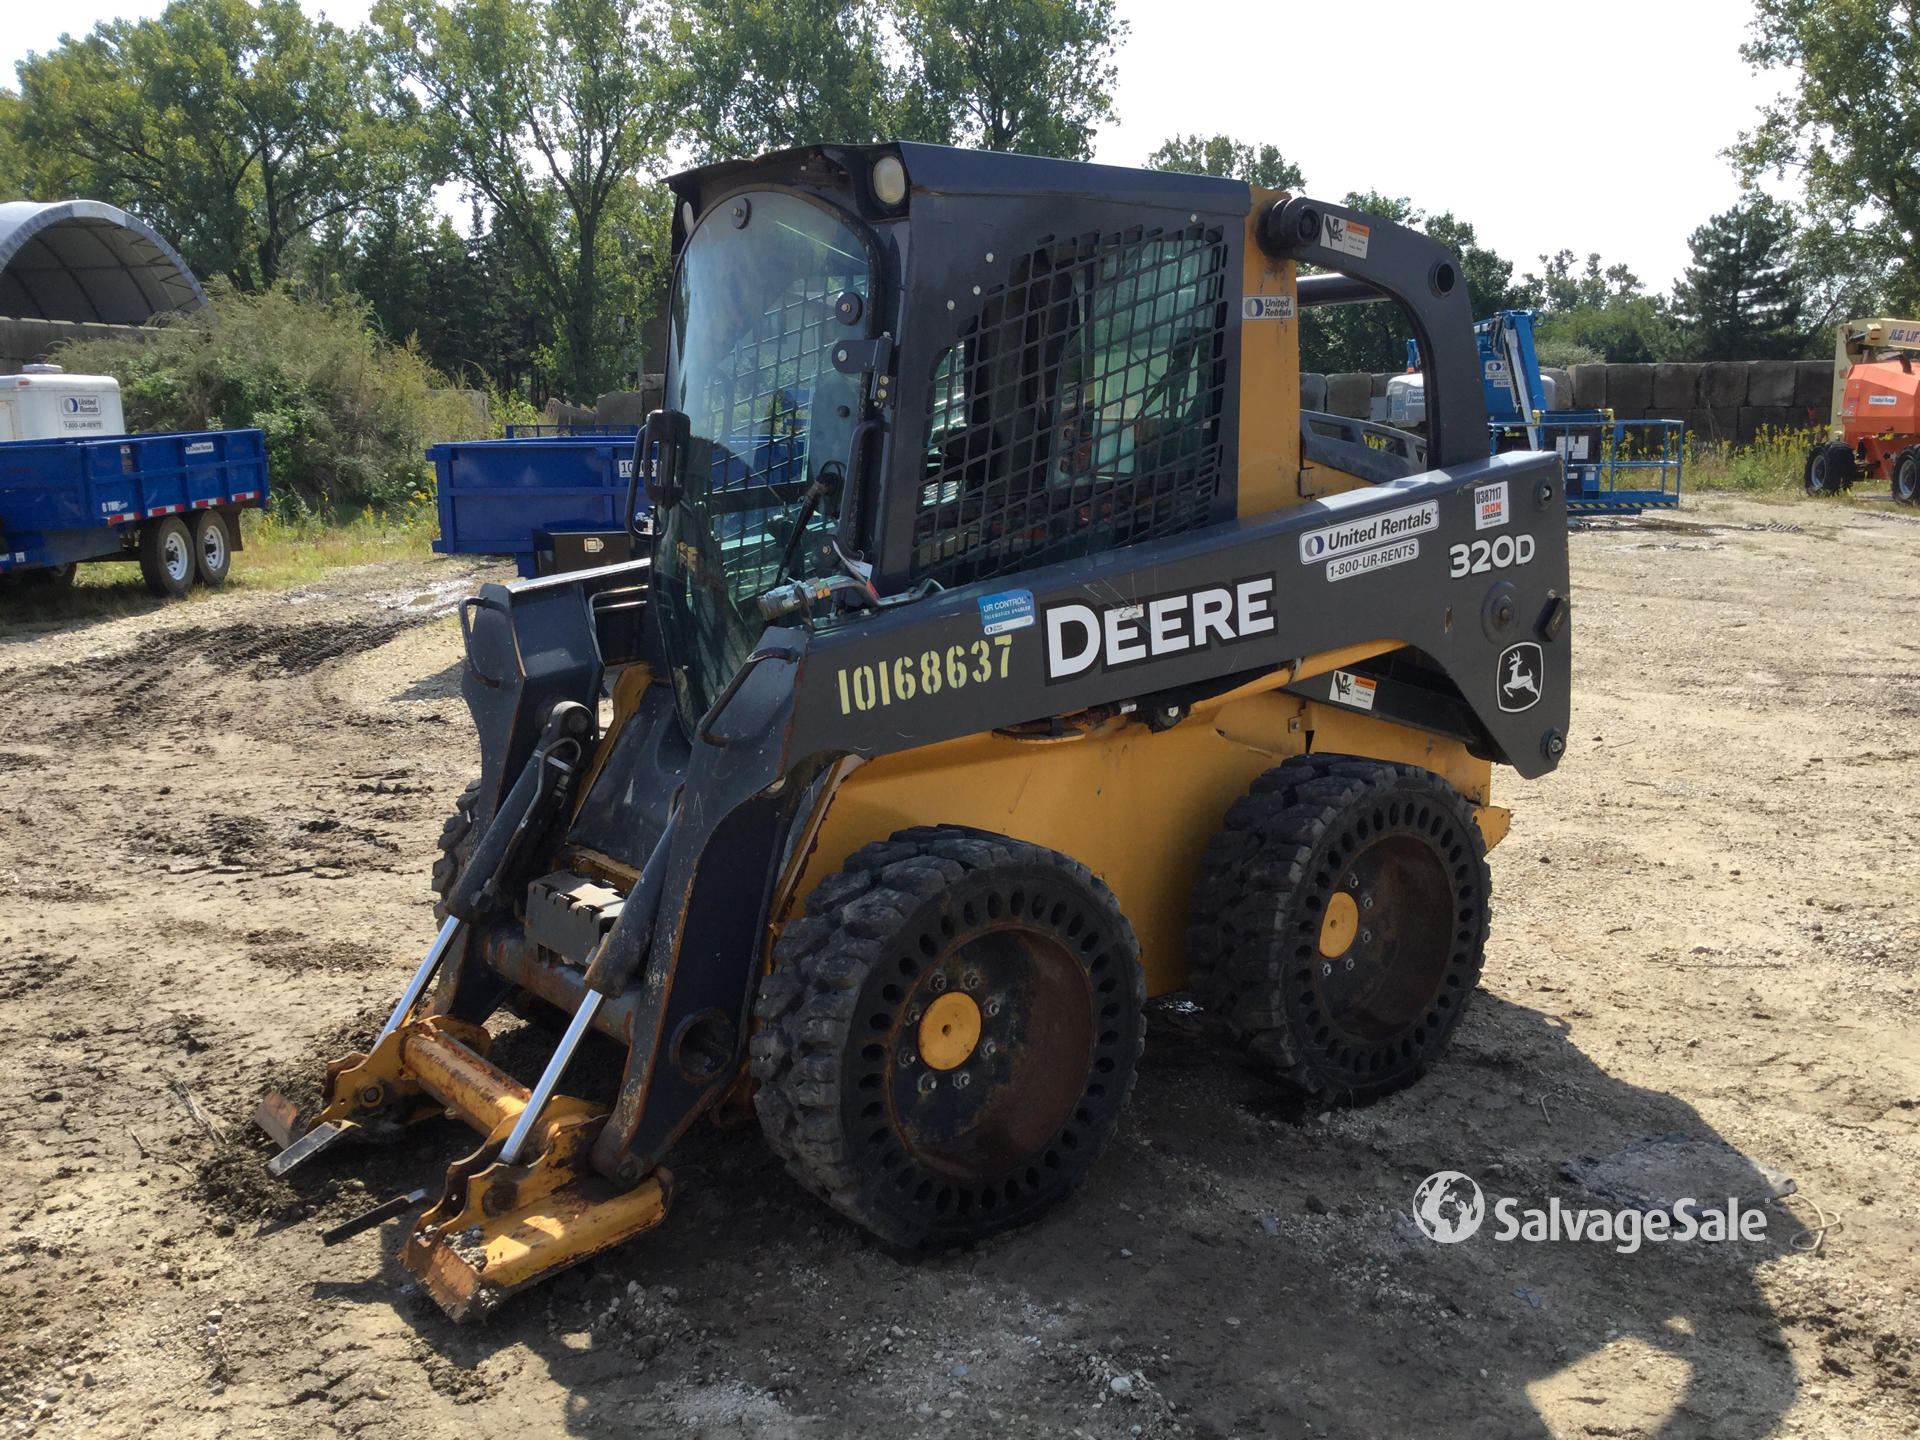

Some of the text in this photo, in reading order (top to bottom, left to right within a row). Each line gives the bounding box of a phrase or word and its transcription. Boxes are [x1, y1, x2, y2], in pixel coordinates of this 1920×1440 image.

[1265, 297, 1290, 308] United
[1265, 308, 1292, 317] Rentals
[1888, 328, 1920, 343] JLG LIF
[1481, 501, 1502, 515] IRON
[1328, 509, 1432, 550] United Rentals
[1329, 542, 1416, 578] 1-800-UR-RENTS
[1449, 533, 1536, 579] 320D
[994, 597, 1026, 609] CONTROL
[1046, 577, 1275, 678] DEERE
[838, 635, 1014, 715] 10168637
